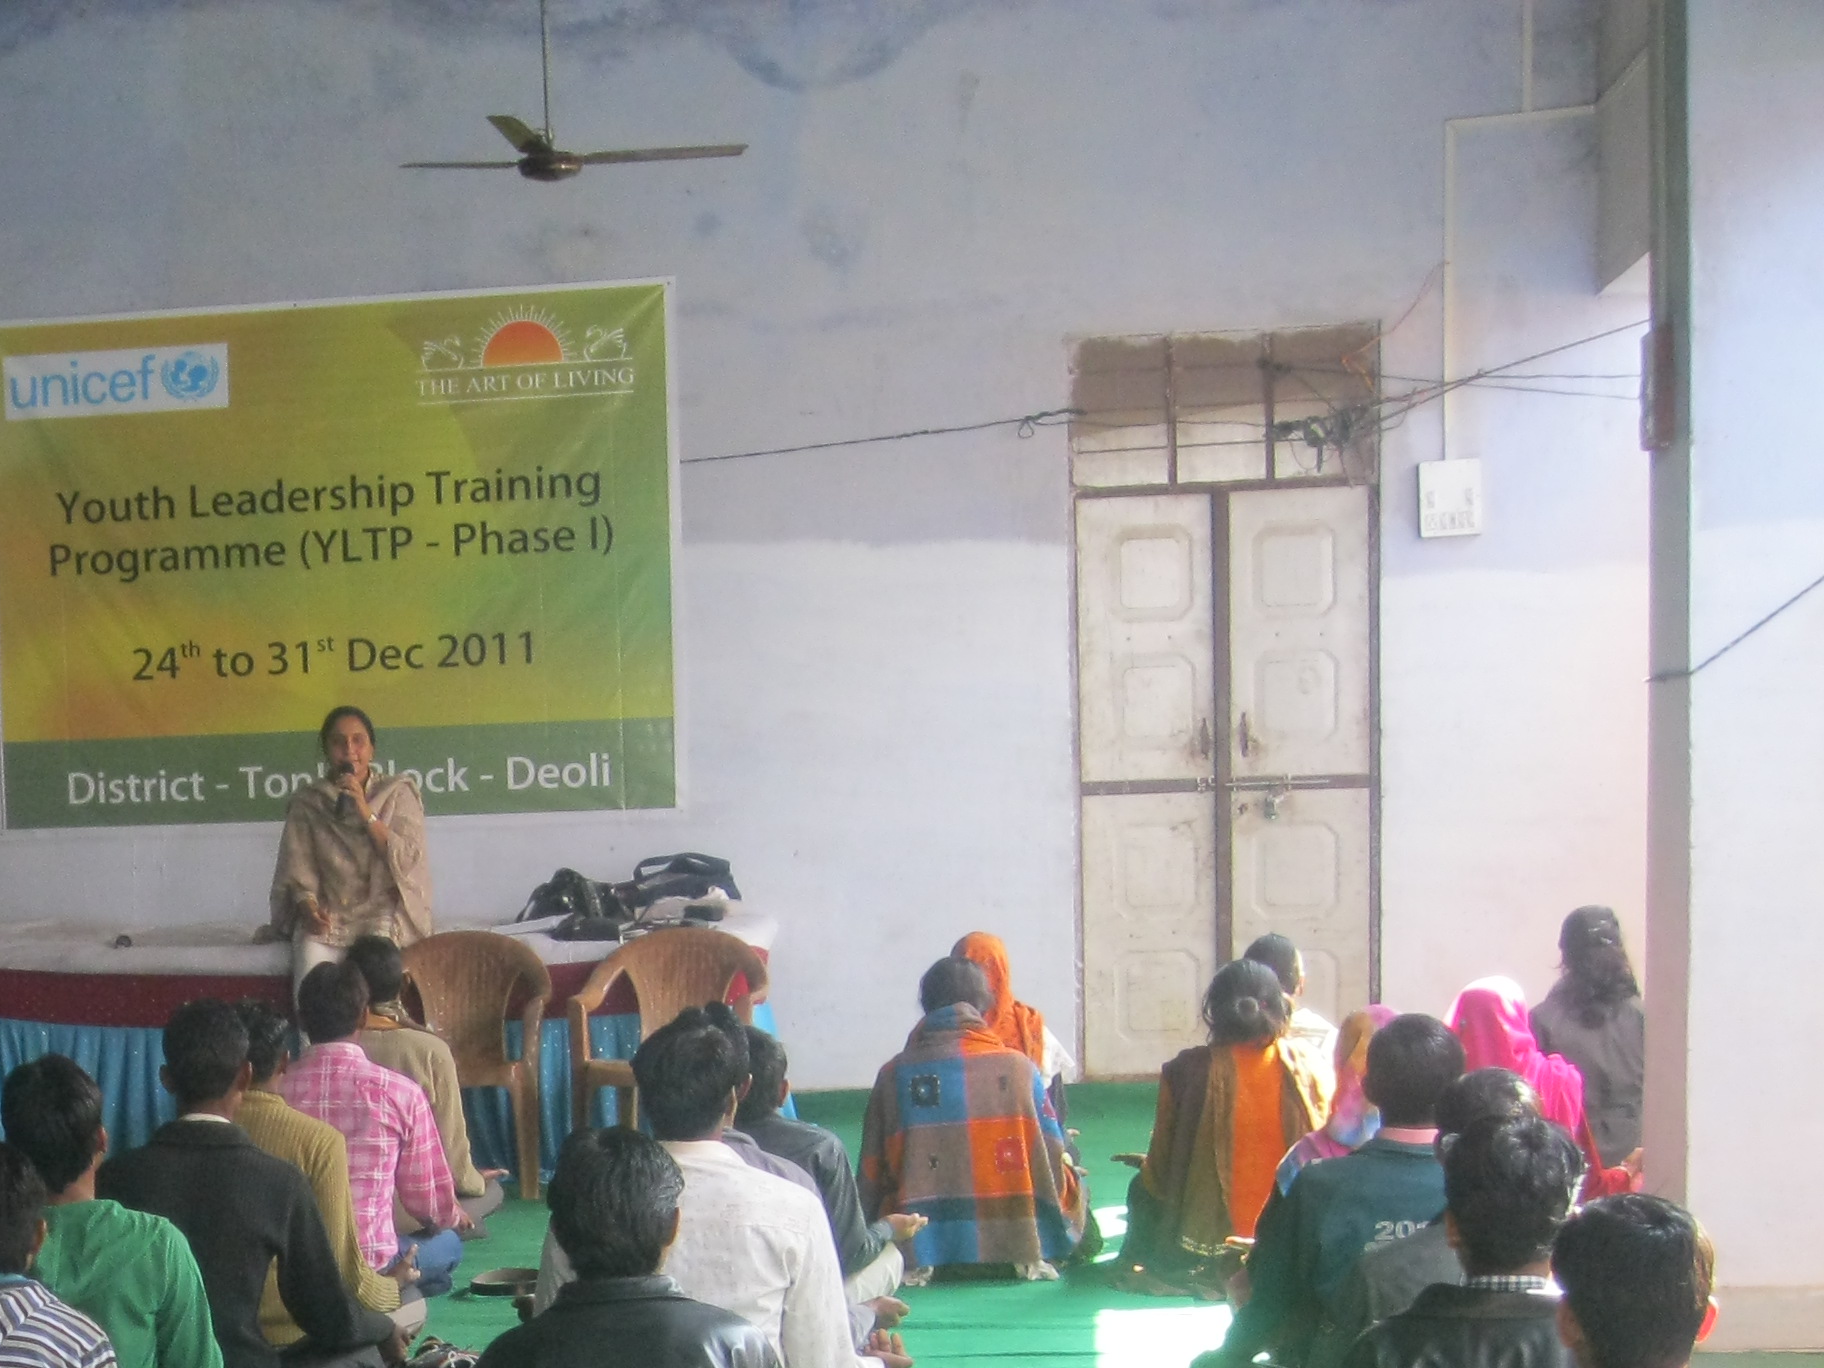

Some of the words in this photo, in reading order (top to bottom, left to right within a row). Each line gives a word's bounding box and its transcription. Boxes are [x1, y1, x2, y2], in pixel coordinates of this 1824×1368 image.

[9, 353, 156, 410] unicef
[415, 378, 459, 397] THE
[466, 373, 510, 394] ART
[516, 371, 547, 390] OF
[553, 367, 635, 389] LIVING
[55, 485, 176, 525] Youth
[189, 474, 415, 518] Leadership
[425, 465, 601, 508] Training
[49, 538, 286, 583] Programme
[300, 525, 413, 570] (YLTP
[453, 520, 576, 557] Phase
[131, 640, 201, 681] 24th
[212, 648, 255, 679] to
[267, 636, 335, 676] 31st
[347, 637, 425, 673] Dec
[436, 630, 535, 668] 2011
[67, 769, 206, 805] District
[506, 752, 611, 791] Deoli
